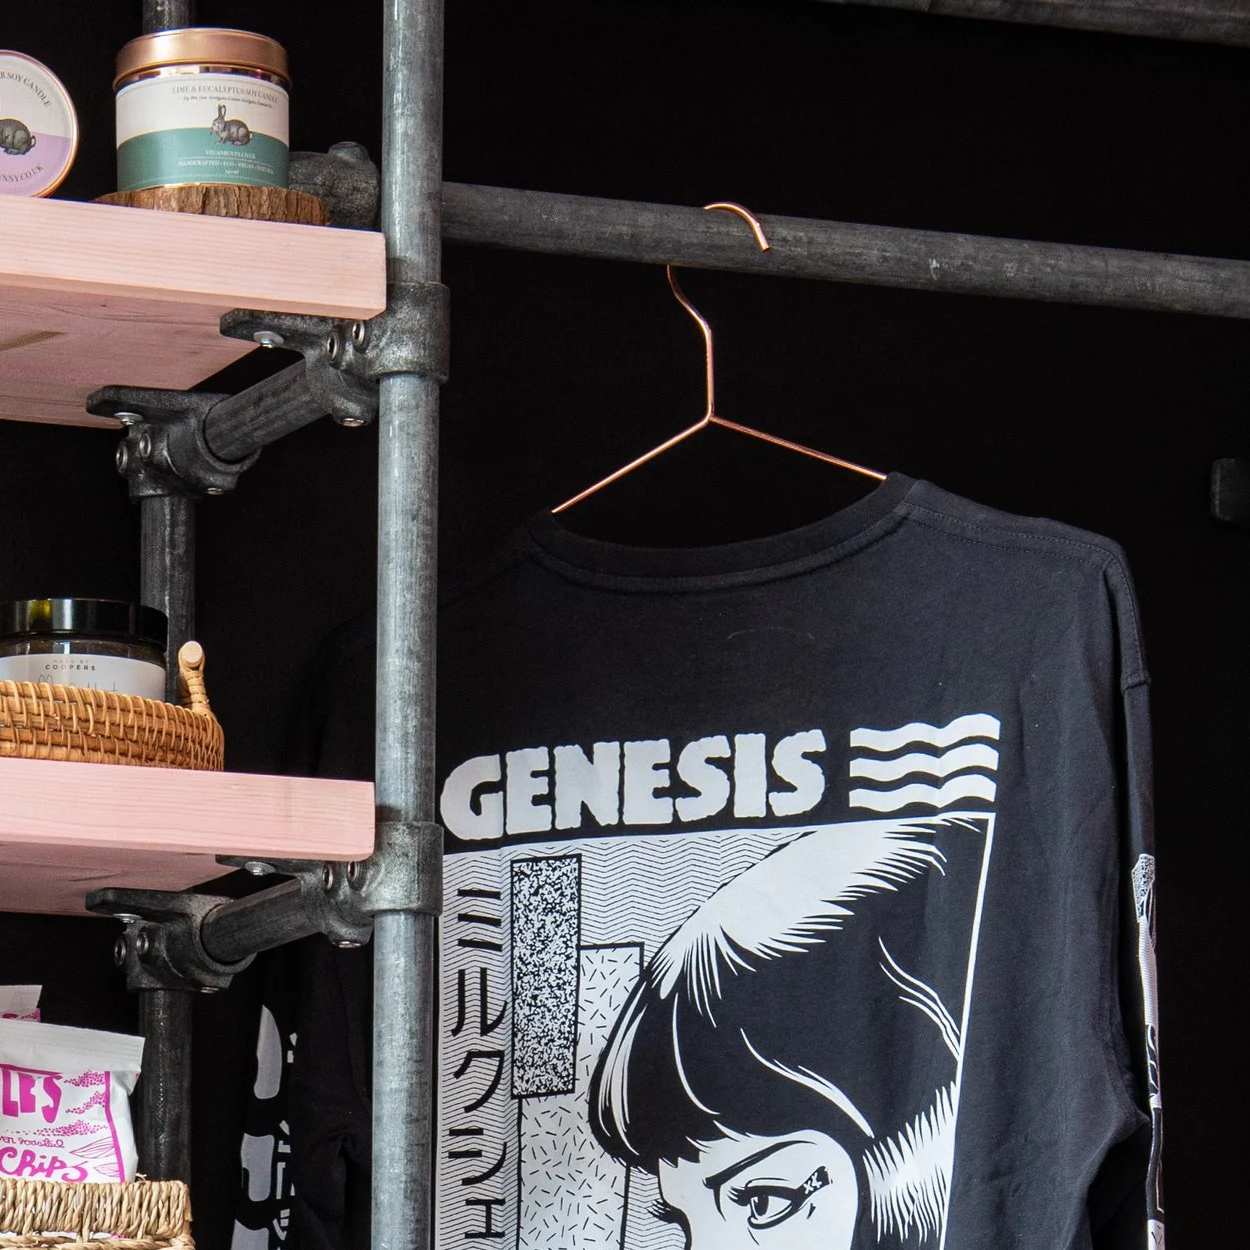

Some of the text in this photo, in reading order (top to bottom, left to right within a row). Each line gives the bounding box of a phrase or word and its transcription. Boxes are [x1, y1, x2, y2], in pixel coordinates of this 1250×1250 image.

[7, 71, 23, 82] SOY
[23, 78, 52, 108] CANDLE
[440, 729, 827, 840] GENESIS
